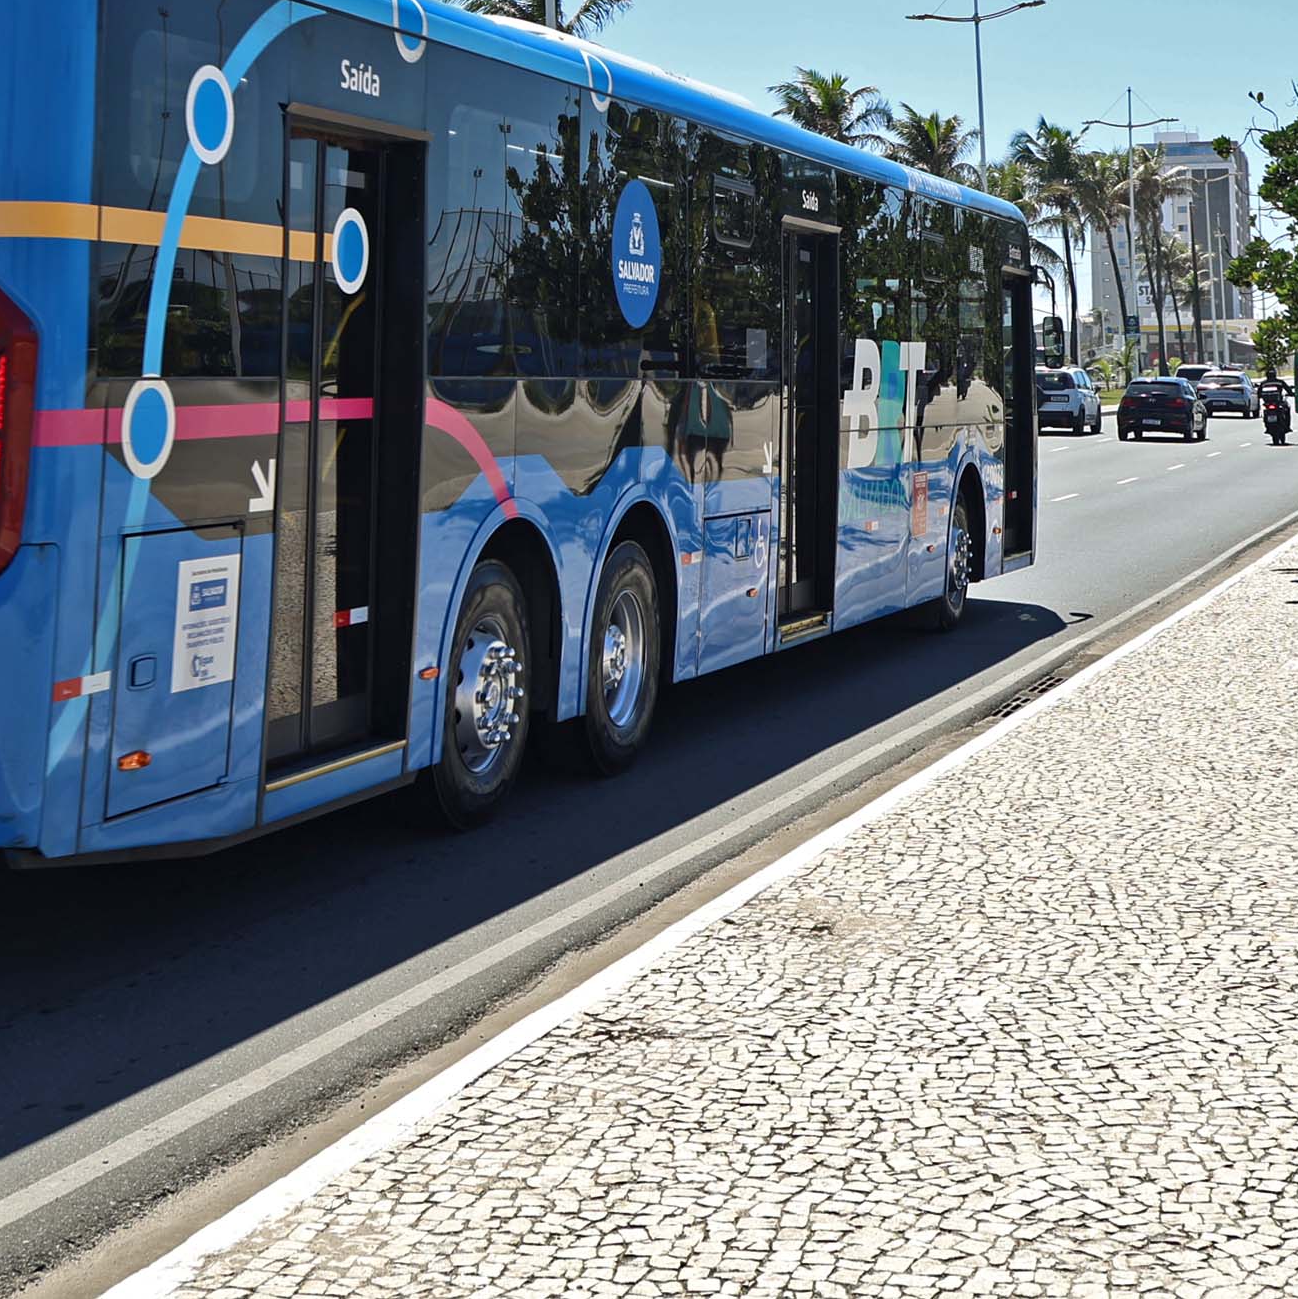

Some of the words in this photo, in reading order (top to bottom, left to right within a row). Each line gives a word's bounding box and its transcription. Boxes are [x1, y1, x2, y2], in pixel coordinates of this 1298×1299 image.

[340, 58, 380, 98] Saída
[618, 259, 655, 284] SALVADOR
[842, 338, 926, 470] BRT
